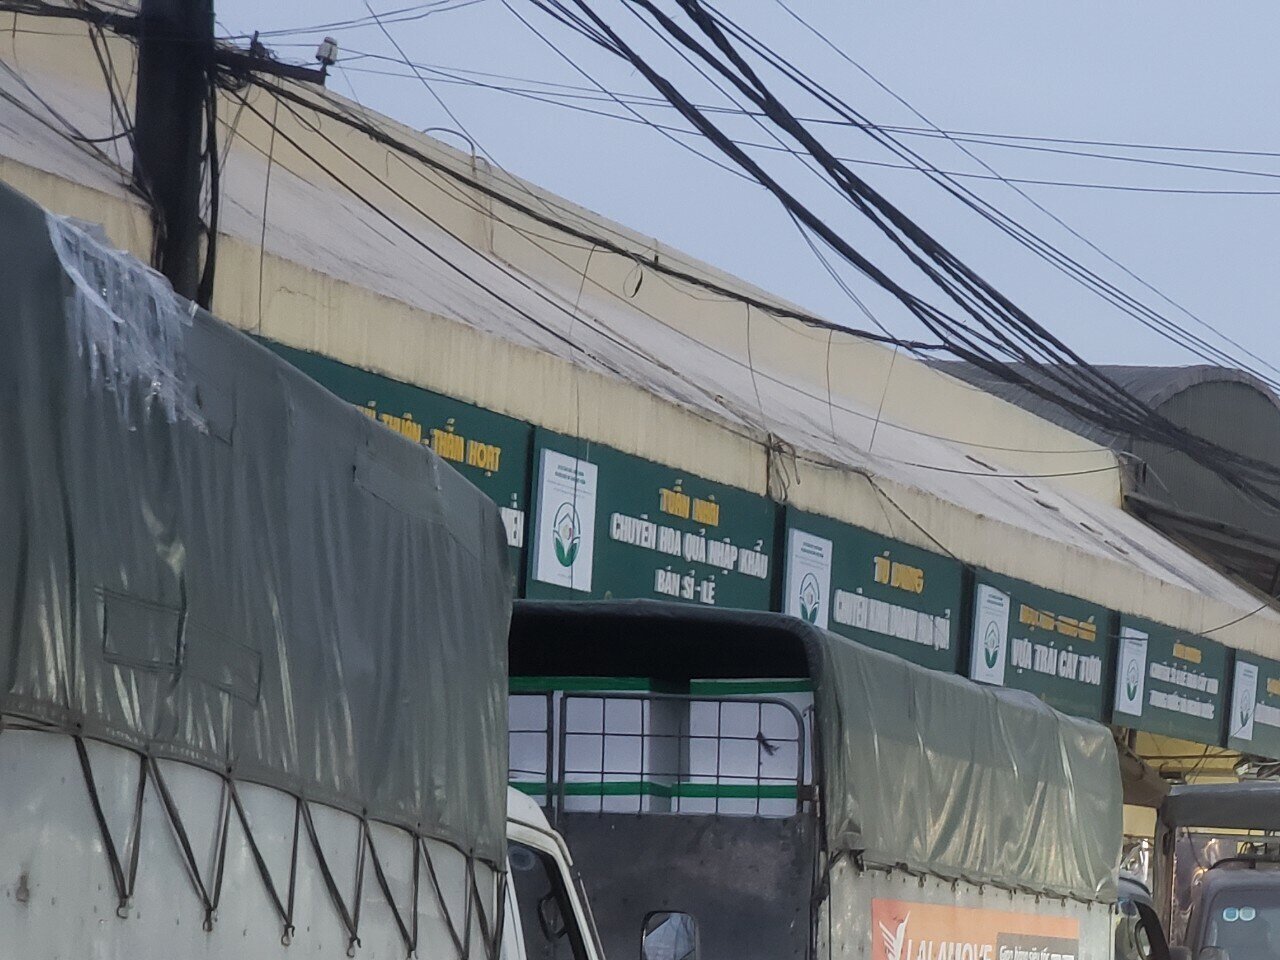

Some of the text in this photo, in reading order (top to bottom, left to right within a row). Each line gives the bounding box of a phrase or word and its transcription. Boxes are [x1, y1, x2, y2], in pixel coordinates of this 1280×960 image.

[610, 512, 769, 579] CHUYÊN HOA QUẢ NHẬP KHẨU
[654, 565, 681, 597] BÁN
[1033, 641, 1058, 676] TRÁI
[1057, 645, 1079, 680] CÂY
